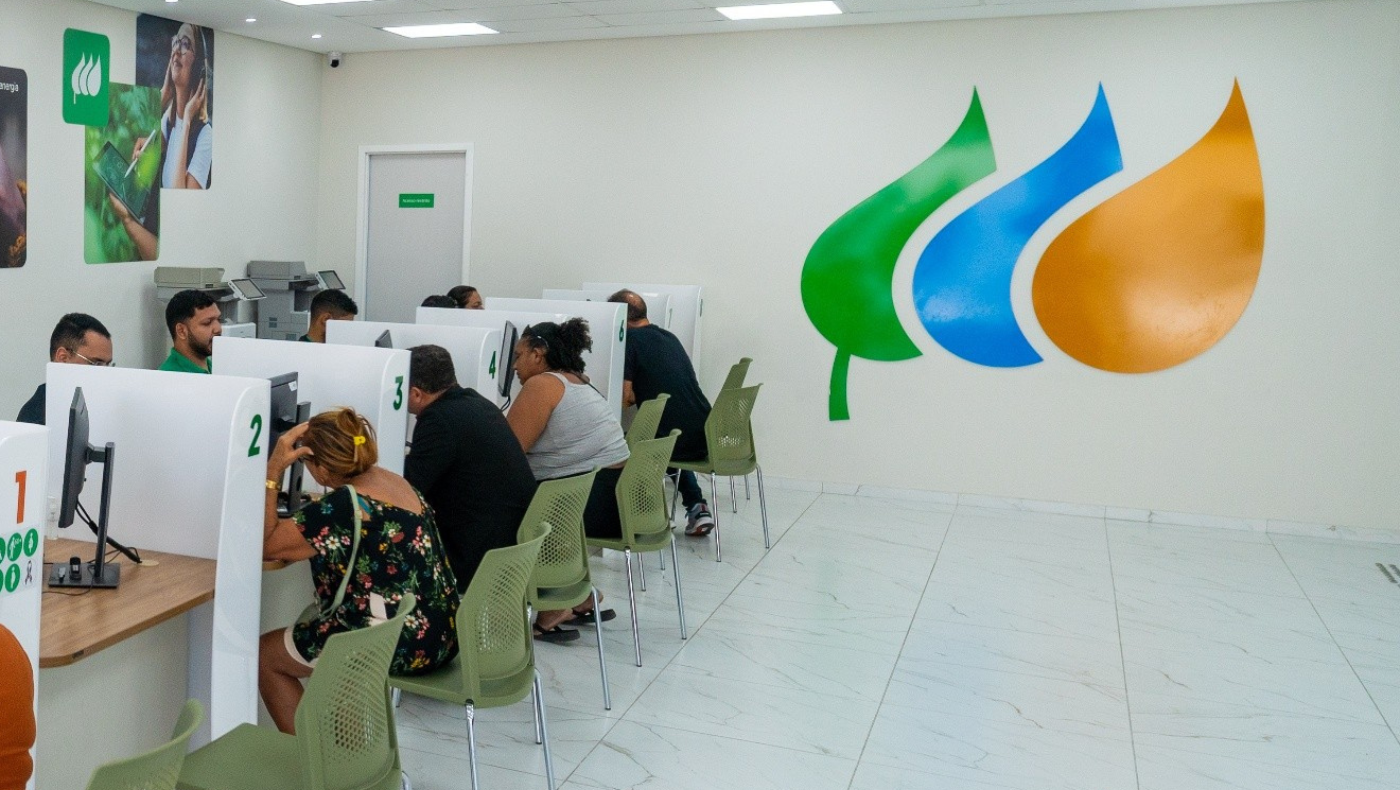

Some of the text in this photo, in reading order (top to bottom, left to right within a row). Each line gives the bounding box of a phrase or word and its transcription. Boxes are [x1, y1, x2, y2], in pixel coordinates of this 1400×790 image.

[619, 319, 624, 342] 6
[488, 351, 497, 379] 4
[393, 376, 404, 411] 3
[248, 414, 262, 458] 2
[15, 470, 27, 524] 1
